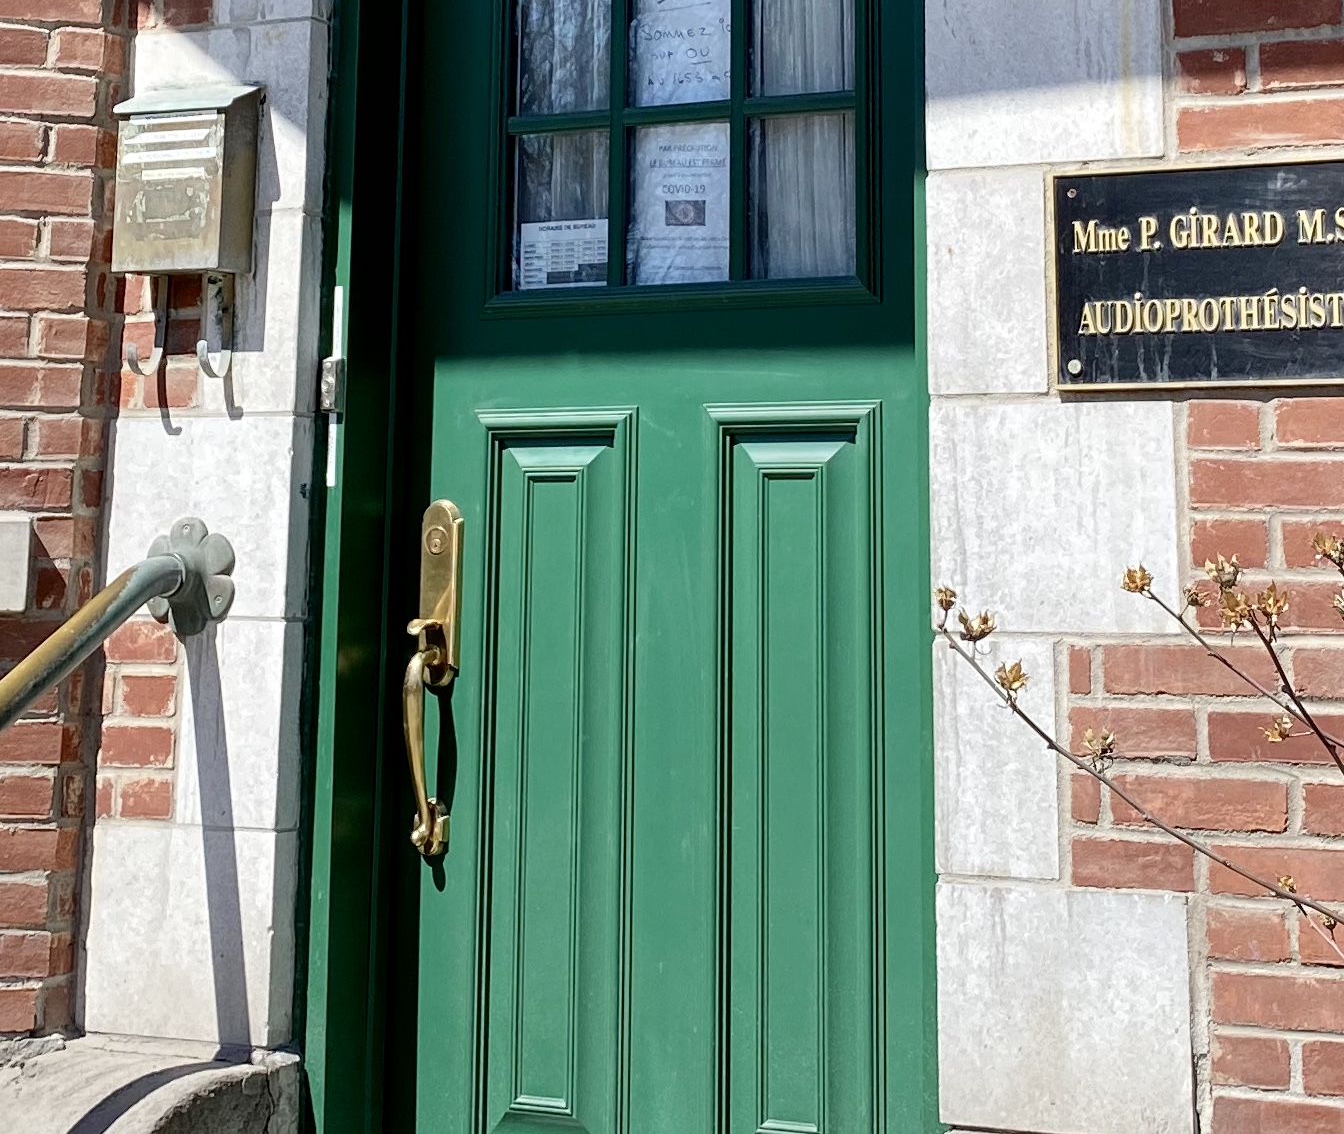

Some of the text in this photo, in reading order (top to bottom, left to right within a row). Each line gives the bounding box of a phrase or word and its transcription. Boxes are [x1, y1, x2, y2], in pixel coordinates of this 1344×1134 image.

[662, 184, 705, 194] COVID-19
[1072, 219, 1131, 255] Mme
[1138, 216, 1162, 251] P.
